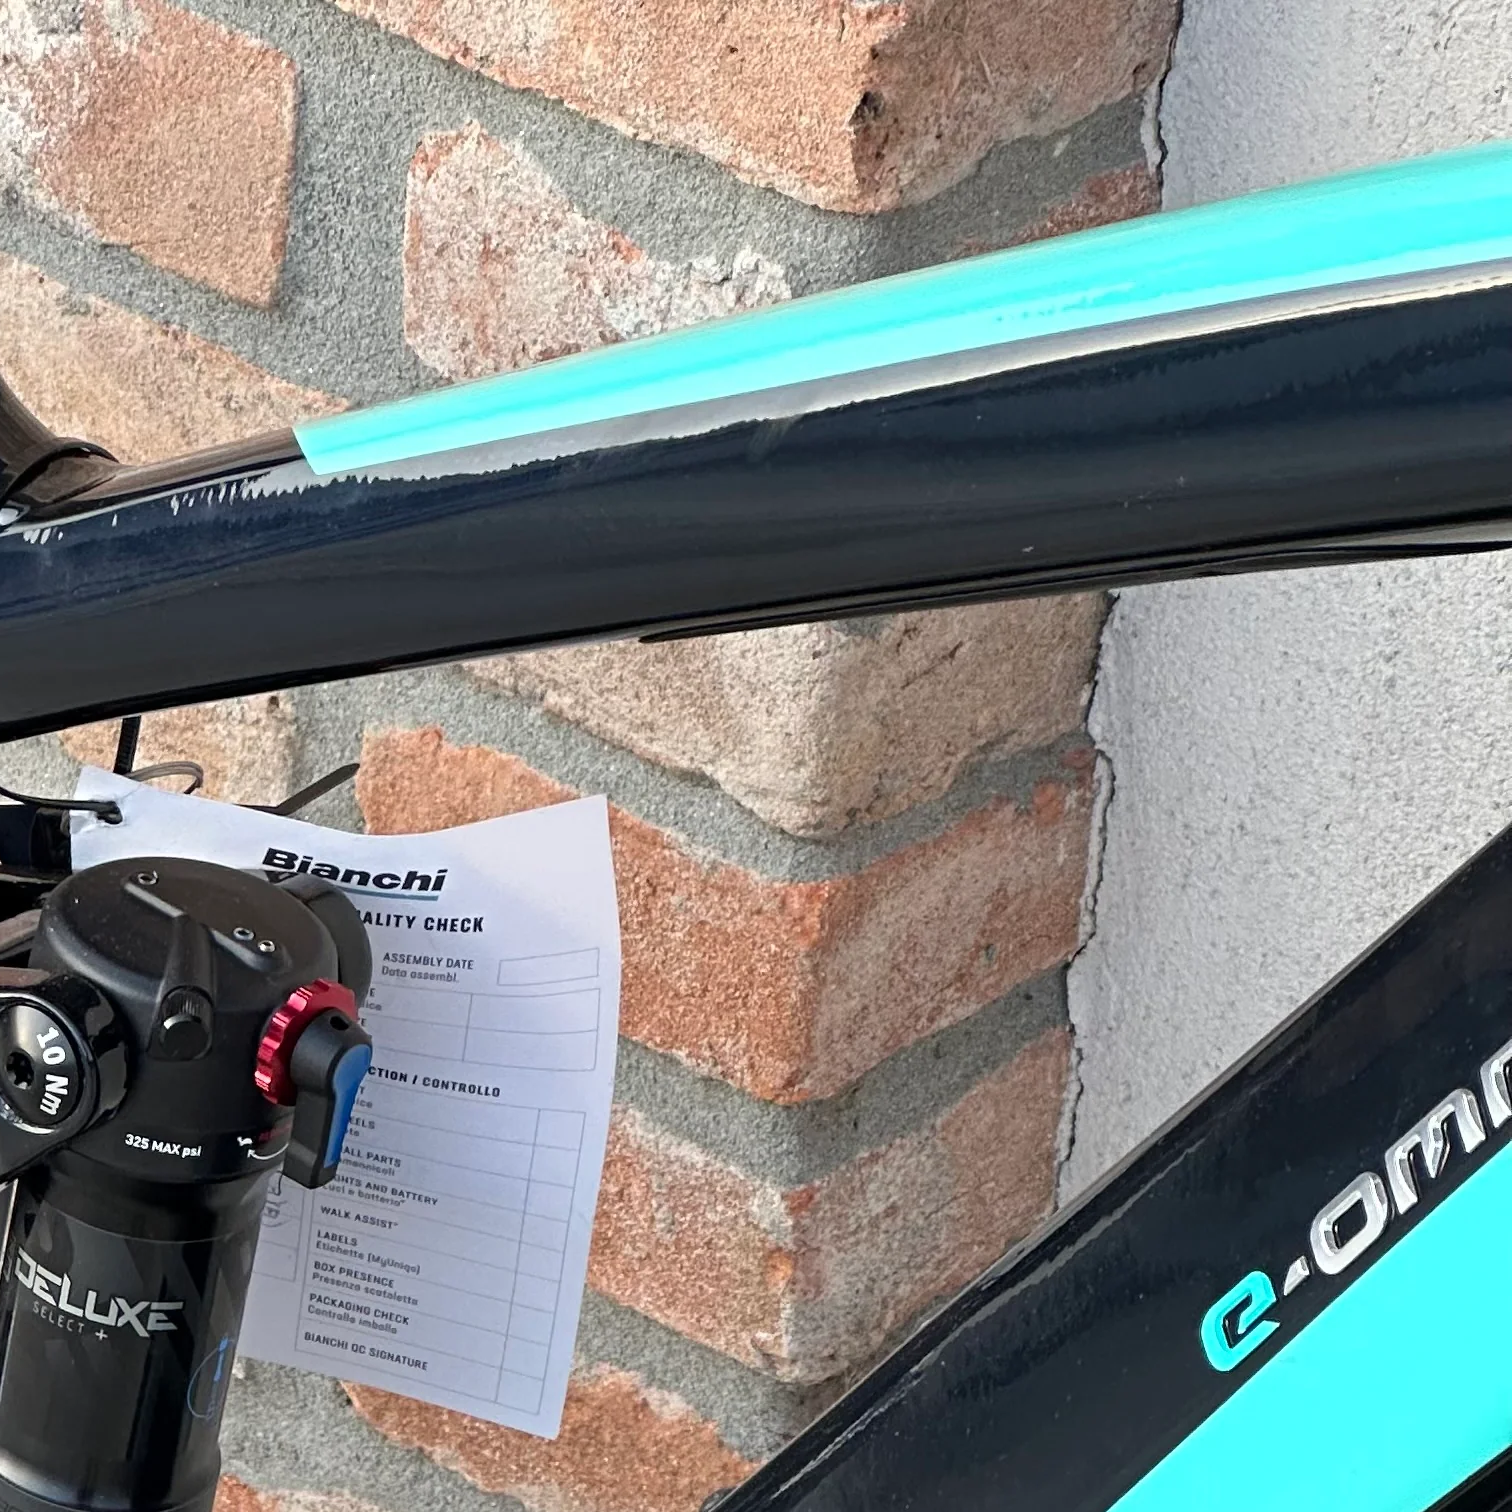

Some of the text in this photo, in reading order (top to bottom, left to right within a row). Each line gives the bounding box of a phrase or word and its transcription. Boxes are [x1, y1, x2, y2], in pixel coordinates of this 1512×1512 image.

[262, 848, 448, 892] Bianchi
[357, 910, 484, 933] ALITY CHECK
[383, 952, 474, 970] ASSEMBLY DATE
[36, 1027, 68, 1115] 10 Nm
[368, 1066, 408, 1083] CTION
[422, 1076, 501, 1098] CONTROLLO
[125, 1133, 202, 1159] 325 MAX psi
[343, 1146, 401, 1168] ALL PARTS
[365, 1182, 388, 1194] AND
[391, 1187, 439, 1206] BATTERY
[321, 1205, 351, 1220] WALK
[316, 1240, 365, 1260] Etichette
[317, 1229, 358, 1247] LABELS
[312, 1271, 361, 1292] Presenza
[314, 1260, 395, 1289] BOX PRESENCE
[15, 1246, 183, 1338] DELUXE
[32, 1301, 85, 1335] SELECT
[309, 1293, 410, 1326] PACKAGING CHECK
[304, 1331, 349, 1350] BIANCHI
[369, 1348, 429, 1371] SIGNATURE
